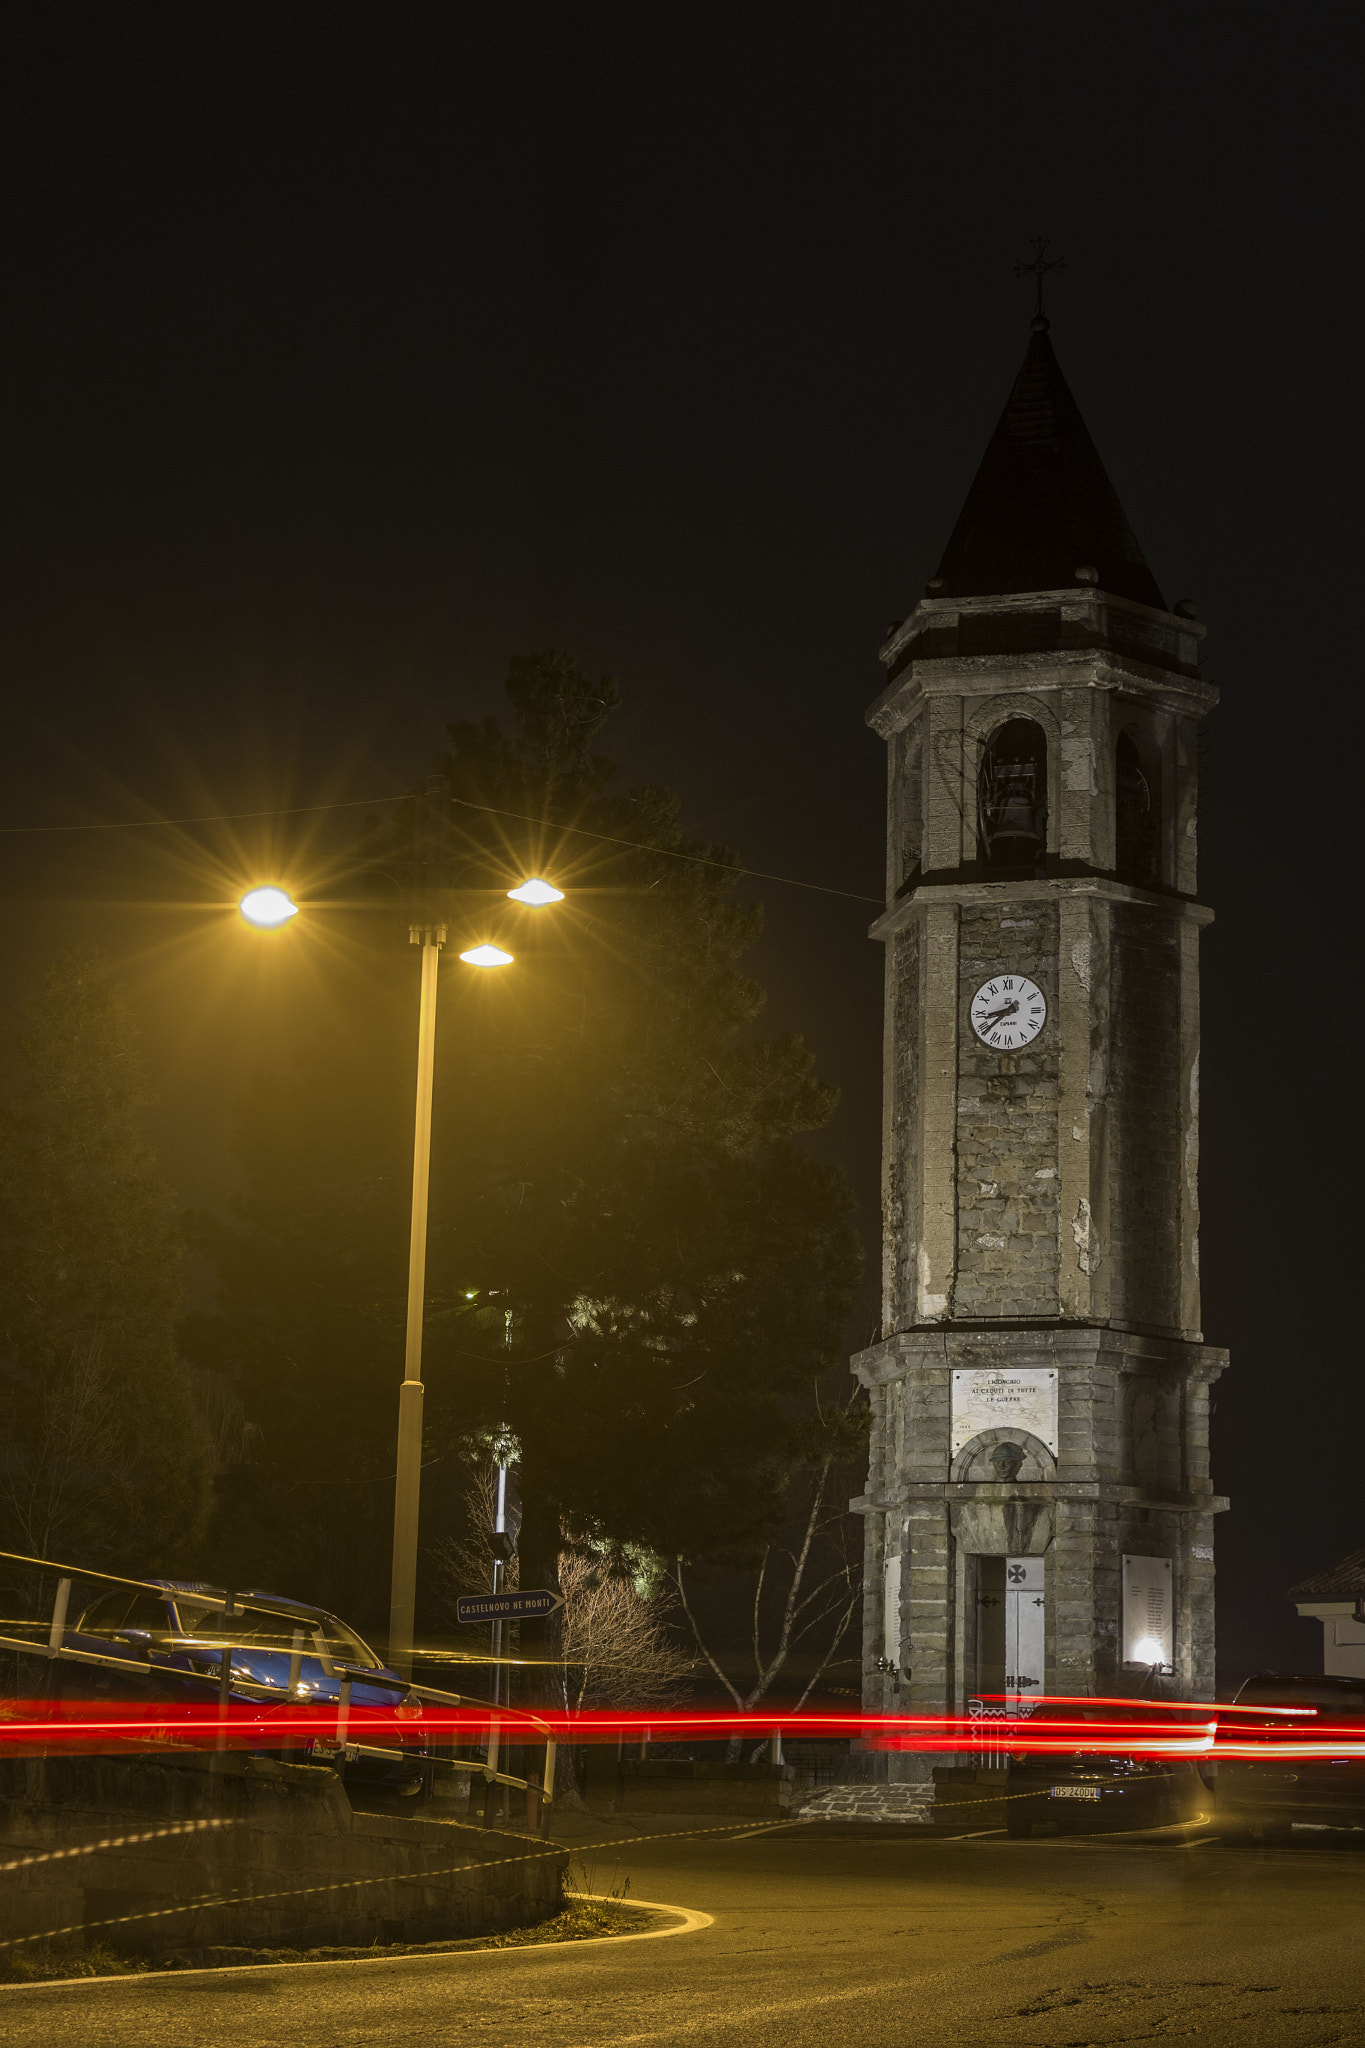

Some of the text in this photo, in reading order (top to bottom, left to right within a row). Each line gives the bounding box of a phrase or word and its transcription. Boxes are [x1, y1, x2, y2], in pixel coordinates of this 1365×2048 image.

[987, 984, 999, 996] XI
[1003, 979, 1013, 990] XII
[978, 995, 990, 1004] X
[1027, 1019, 1039, 1030] IV
[990, 1031, 1001, 1044] VII
[1004, 1035, 1013, 1045] VI
[1019, 1031, 1027, 1041] V
[460, 1602, 510, 1614] CASTELNOVO
[525, 1598, 550, 1609] MONTI
